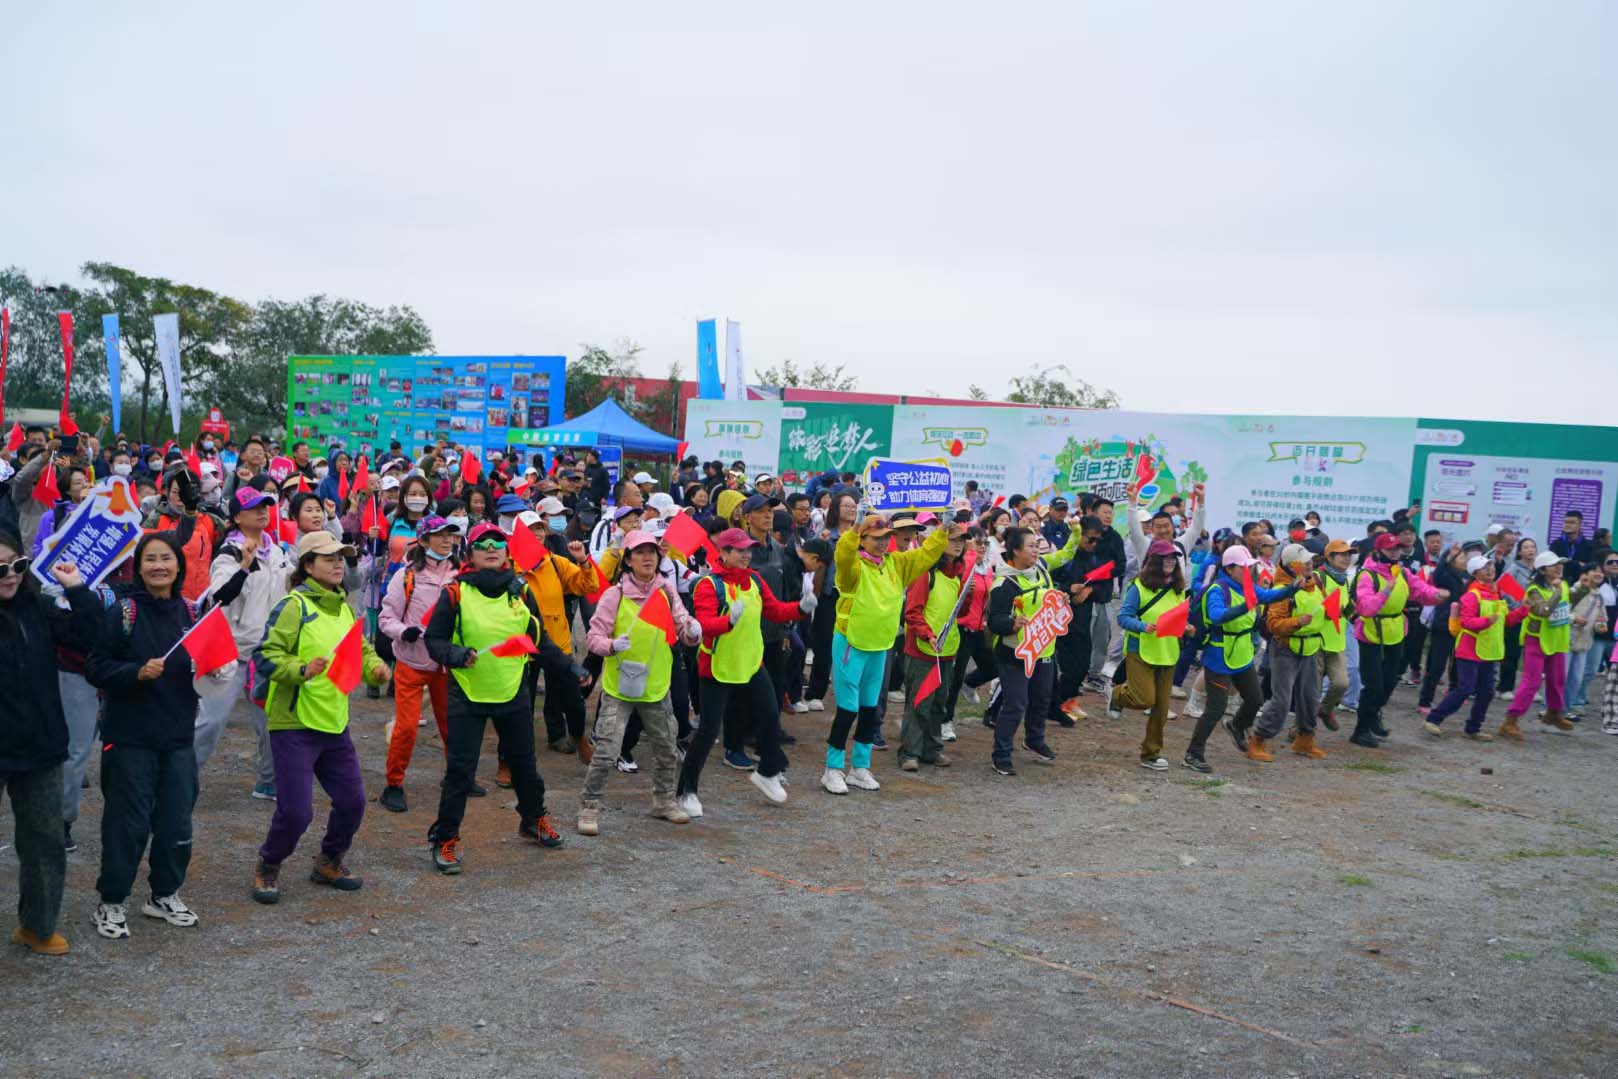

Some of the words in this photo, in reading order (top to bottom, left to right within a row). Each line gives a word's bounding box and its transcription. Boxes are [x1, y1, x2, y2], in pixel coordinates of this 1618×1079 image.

[788, 421, 878, 469] 体彩追梦人
[886, 471, 949, 486] 坚守公益初心
[1071, 458, 1133, 483] 绿色生活
[888, 489, 948, 503] 助力体育强国
[46, 522, 100, 581] 发展体育
